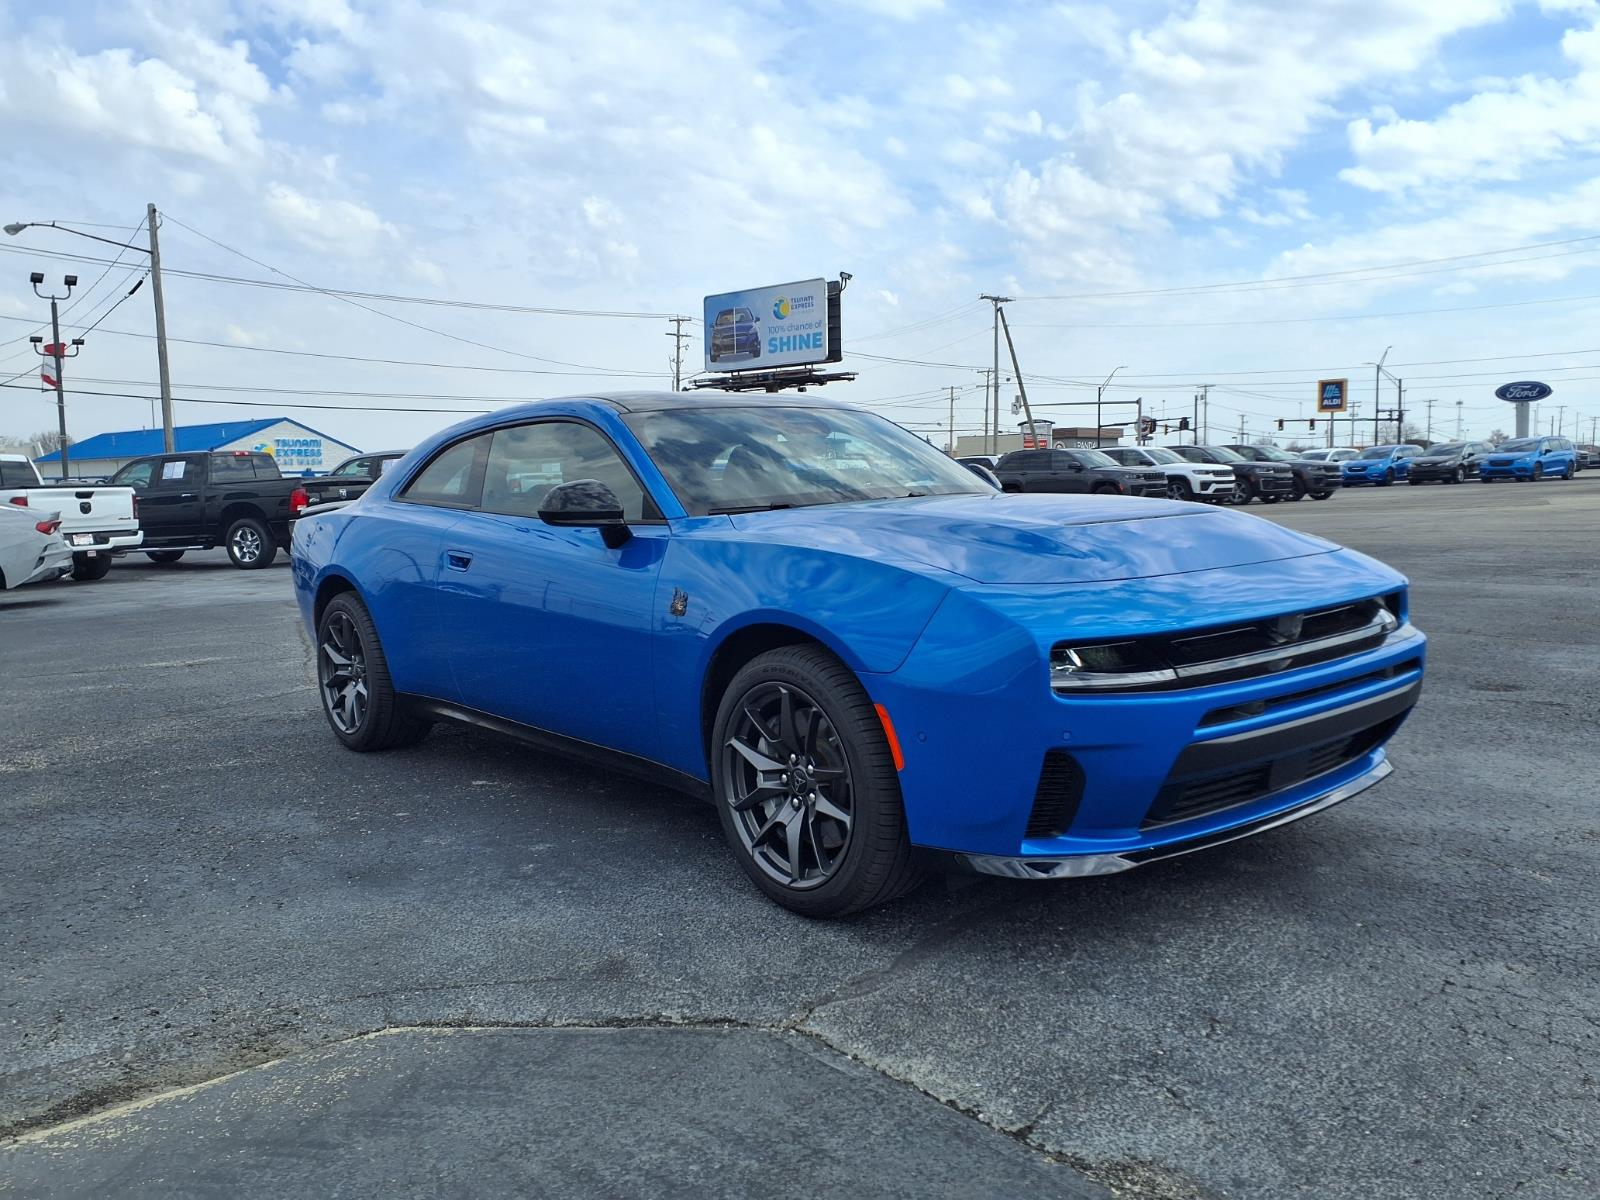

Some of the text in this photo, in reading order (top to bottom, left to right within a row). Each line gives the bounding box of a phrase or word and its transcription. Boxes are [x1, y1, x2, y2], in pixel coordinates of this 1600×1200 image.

[791, 302, 814, 310] EXPRESS
[768, 320, 822, 334] 100% chance of
[768, 332, 823, 354] SHINE
[1506, 385, 1539, 398] Ford
[1322, 398, 1341, 406] ALDI
[274, 439, 321, 447] TSUNAMI
[275, 448, 321, 457] EXPRESS
